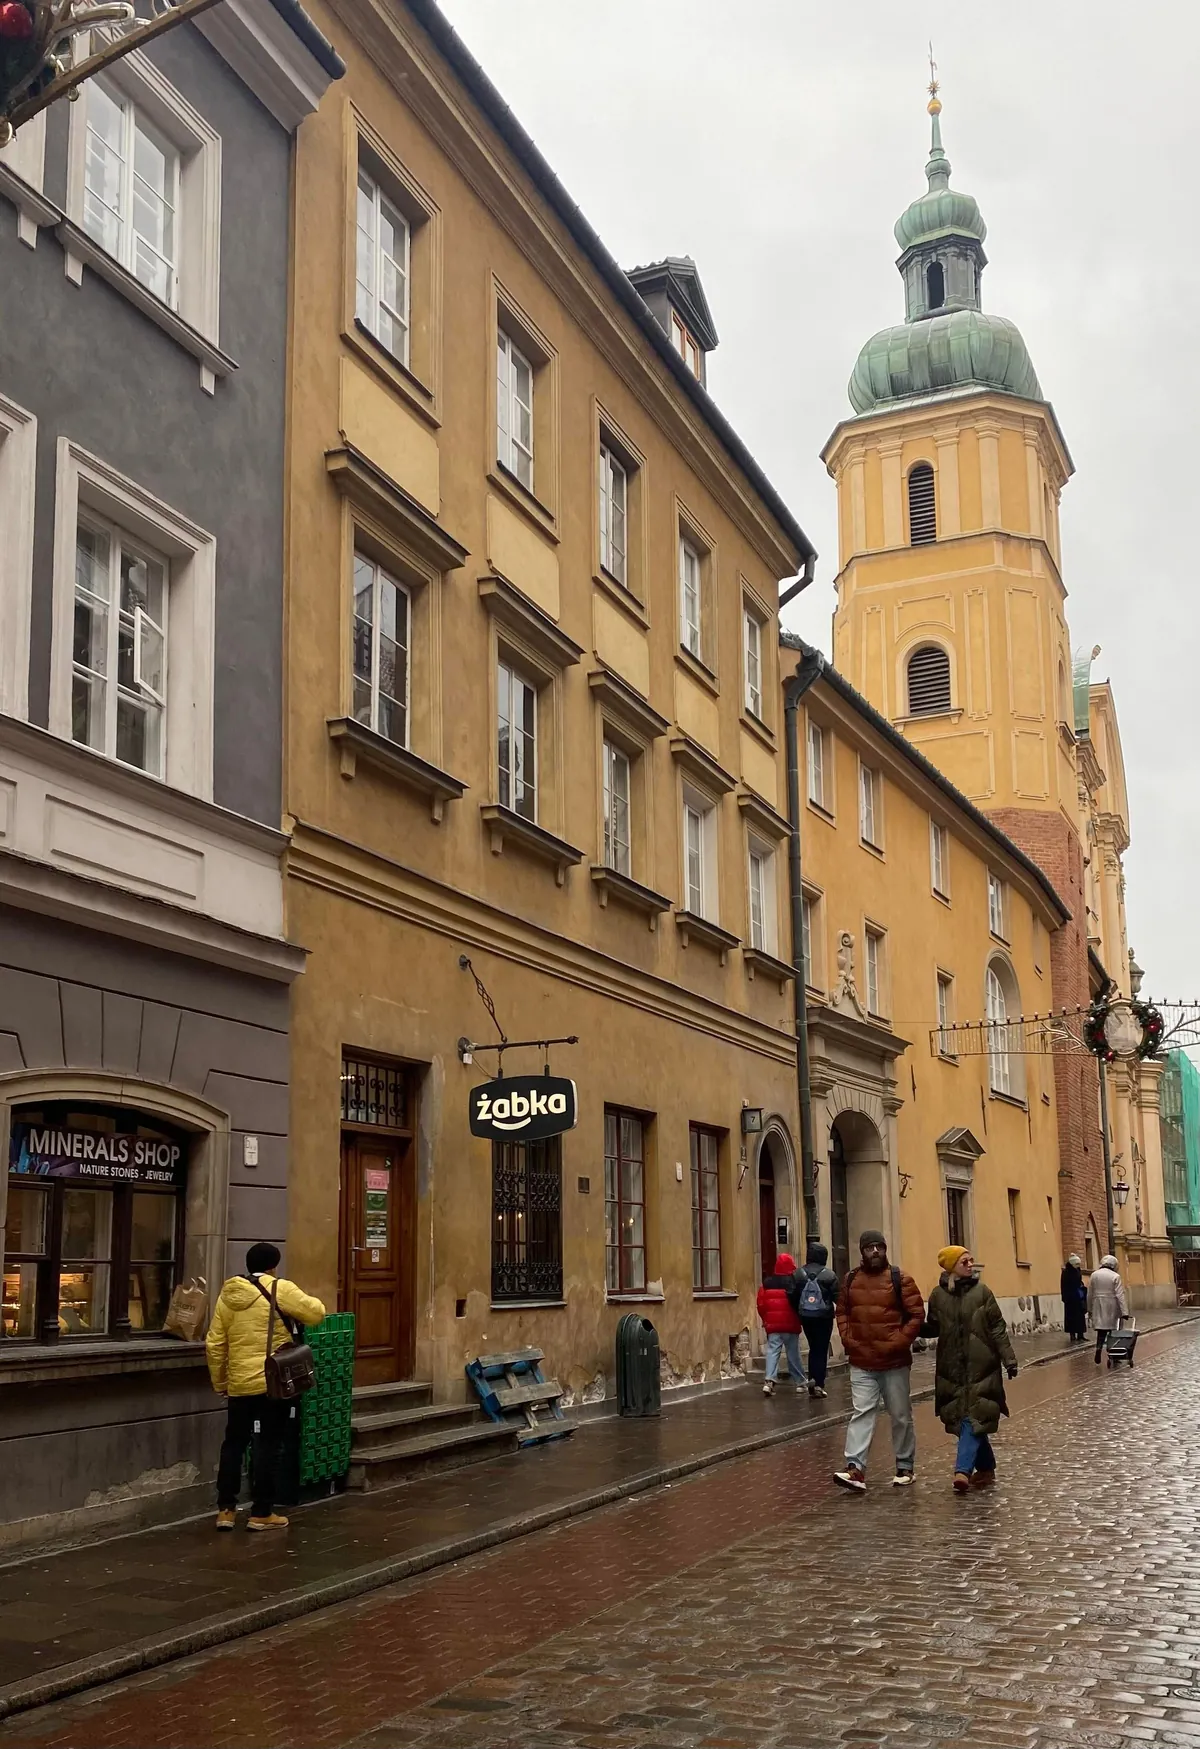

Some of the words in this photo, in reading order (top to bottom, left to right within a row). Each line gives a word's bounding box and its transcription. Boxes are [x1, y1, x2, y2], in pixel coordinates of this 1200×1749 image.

[477, 1090, 566, 1120] żabka
[29, 1128, 128, 1162] MINERALS
[134, 1141, 180, 1167] SHOP
[79, 1164, 109, 1176] NATURE
[110, 1167, 139, 1178] STONES
[145, 1171, 173, 1181] JEWELRY
